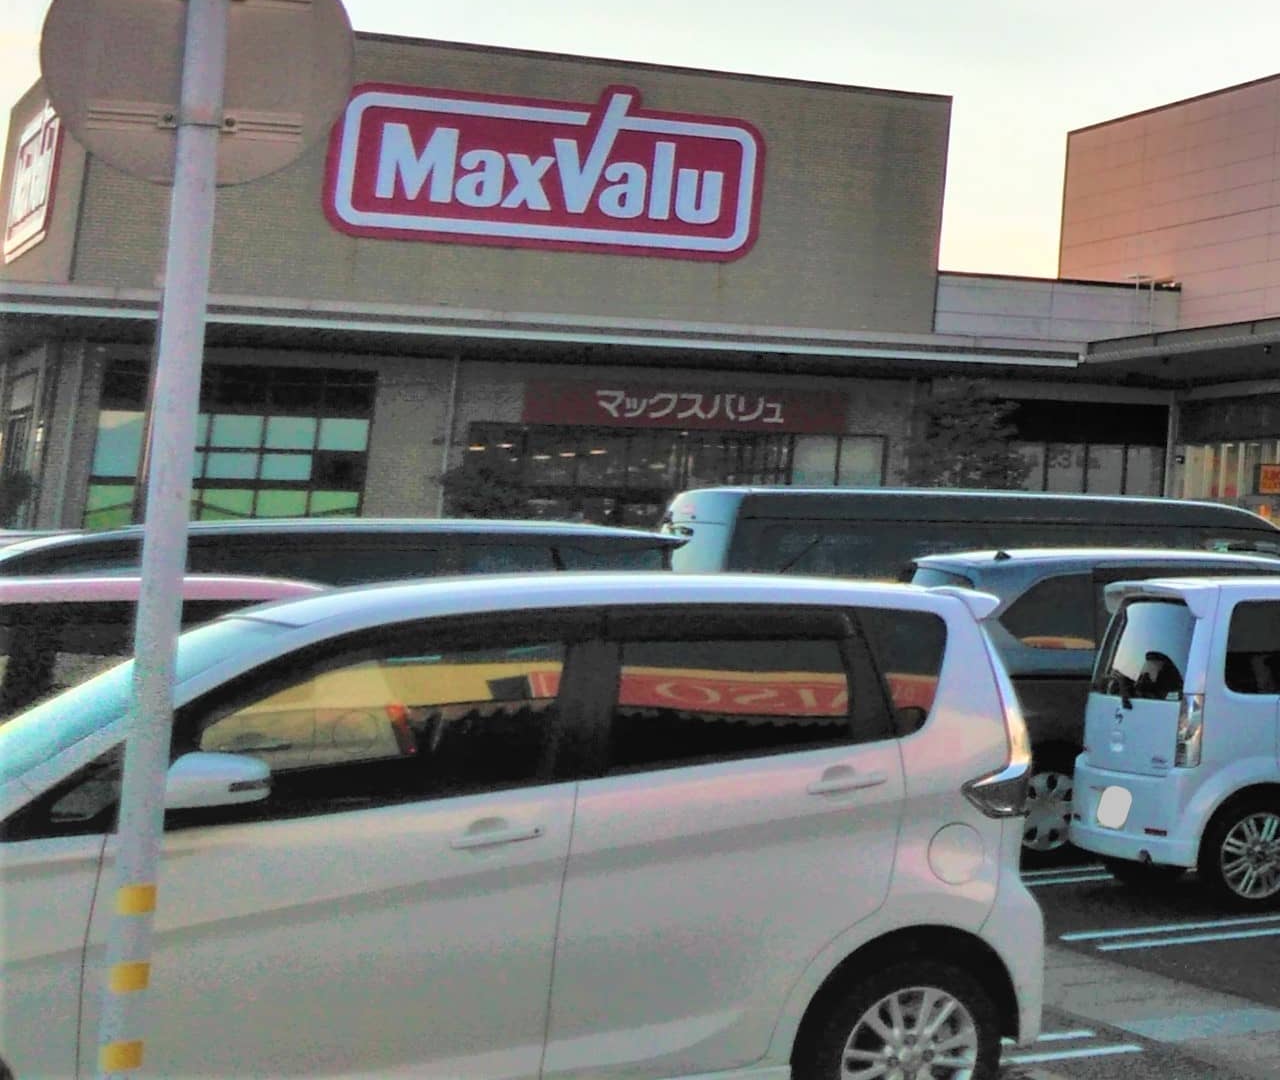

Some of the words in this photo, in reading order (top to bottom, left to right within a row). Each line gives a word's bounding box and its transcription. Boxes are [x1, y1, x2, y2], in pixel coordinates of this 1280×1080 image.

[375, 94, 724, 224] MaxValu
[596, 389, 784, 424] マックスバリュ
